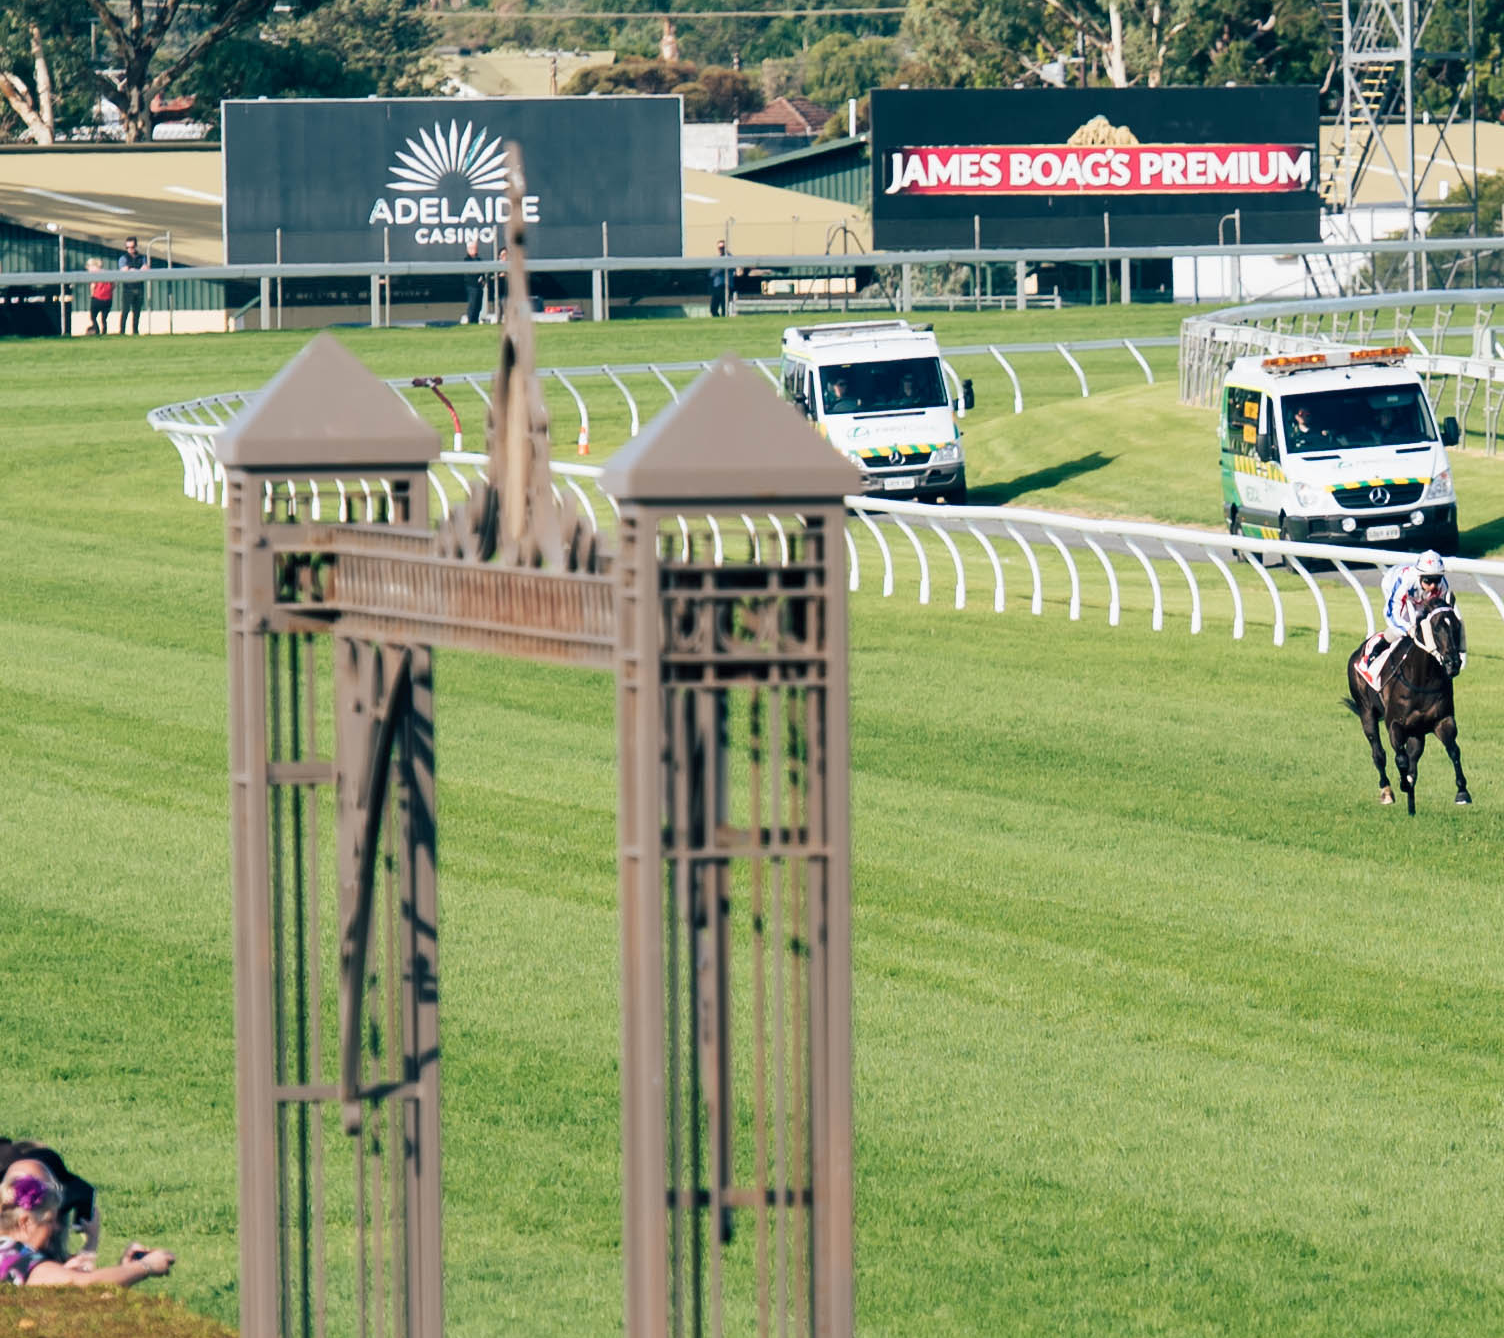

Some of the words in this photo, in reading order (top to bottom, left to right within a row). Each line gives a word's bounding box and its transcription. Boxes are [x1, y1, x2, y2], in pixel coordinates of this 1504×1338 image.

[885, 152, 1001, 194] JAMES
[1009, 148, 1131, 187] BOAG'S
[1140, 150, 1311, 185] PREMIUM
[368, 196, 540, 224] ADELAIDE
[415, 227, 495, 245] CASINO
